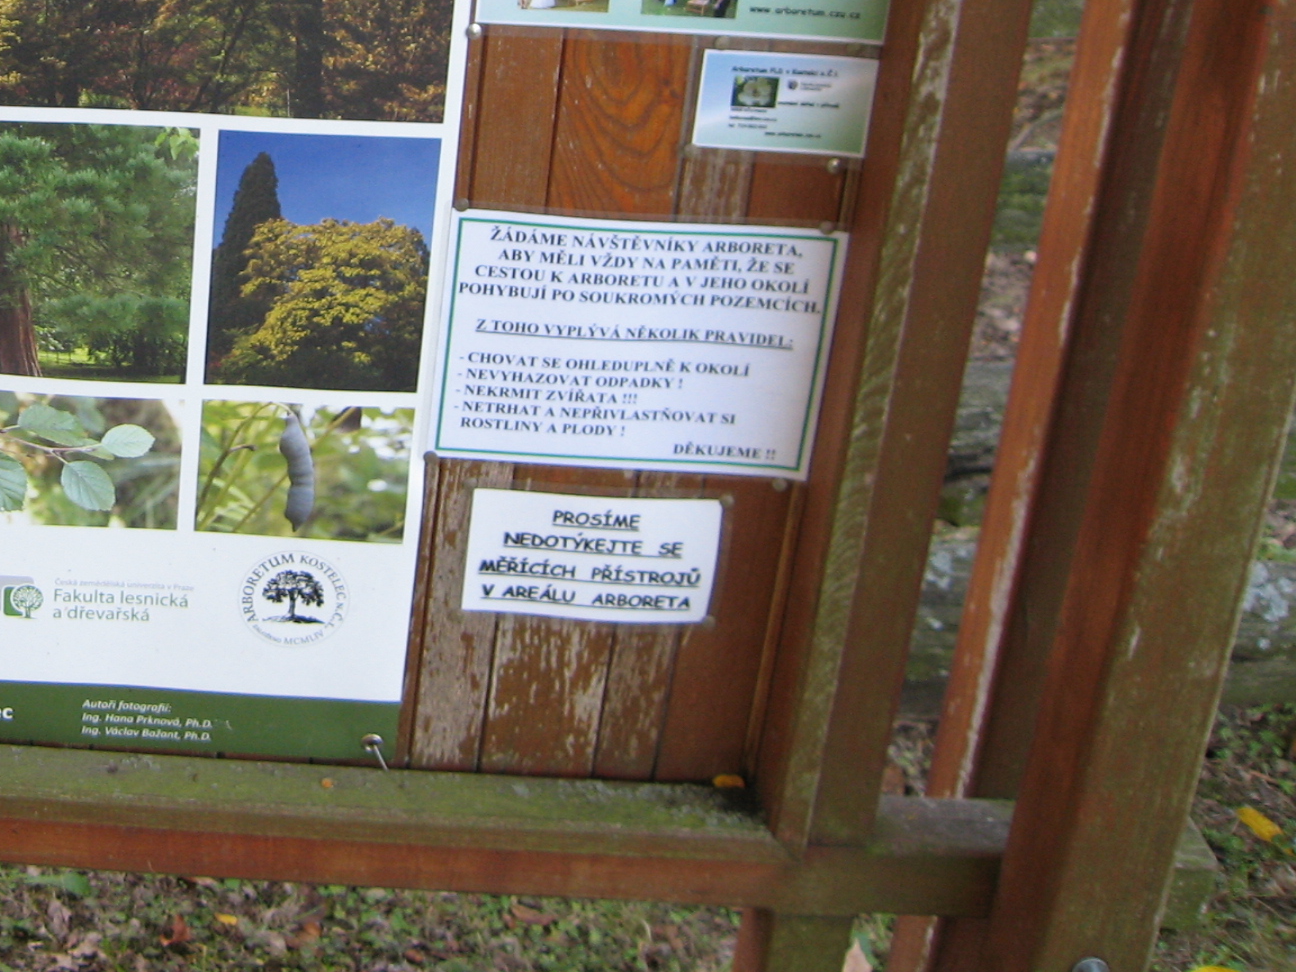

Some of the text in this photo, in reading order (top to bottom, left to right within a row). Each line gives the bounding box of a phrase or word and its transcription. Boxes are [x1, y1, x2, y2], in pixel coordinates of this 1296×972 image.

[490, 228, 568, 248] ŽÁDÁME
[572, 229, 698, 252] NÁVŠTĚVNÍKY
[498, 247, 795, 274] ABY MĚLI VŽDY NA PAMĚTI, ŽE SE
[474, 264, 810, 295] CESTOU K ARBORETU A V JEHO OKOLÍ
[458, 279, 822, 314] POHYBUJÍ PO SOUKROMÝCH POZEMCÍCH.
[475, 318, 794, 349] Z TOHO VYPLÝVÁ NĚKOLIK PRAVIDEL:
[468, 352, 749, 376] CHOVAT SE OHLEDUPLNĚ K OKOLÍ
[466, 368, 673, 390] NEVYHAZOVAT ODPADKY
[464, 384, 618, 404] NEKRMIT ZVÍŘATA
[463, 400, 736, 425] NETRHAT A NEPŘIVLASTŇOVAT SI
[460, 416, 618, 437] ROSTLINY A PLODY
[673, 441, 761, 460] DĚKUJEME
[552, 509, 641, 529] PROSÍME
[504, 532, 684, 556] NEDOTÝKEJTE SE
[479, 556, 701, 586] MĚŘÍCÍCH PŘÍSTROJŮ
[54, 588, 189, 608] Fakulta lesnická
[242, 553, 295, 623] ARBORETUM
[300, 554, 346, 600] KOSTELEC
[482, 582, 690, 610] V AREÁLU ARBORETA
[53, 606, 149, 622] a dřevařská
[284, 630, 325, 646] MCMLIV
[82, 698, 115, 710] Autoři
[82, 712, 213, 728] Ing. Hana Prknová, Ph.D.
[82, 725, 212, 742] Ing. Václav Bažant, Ph.D.
